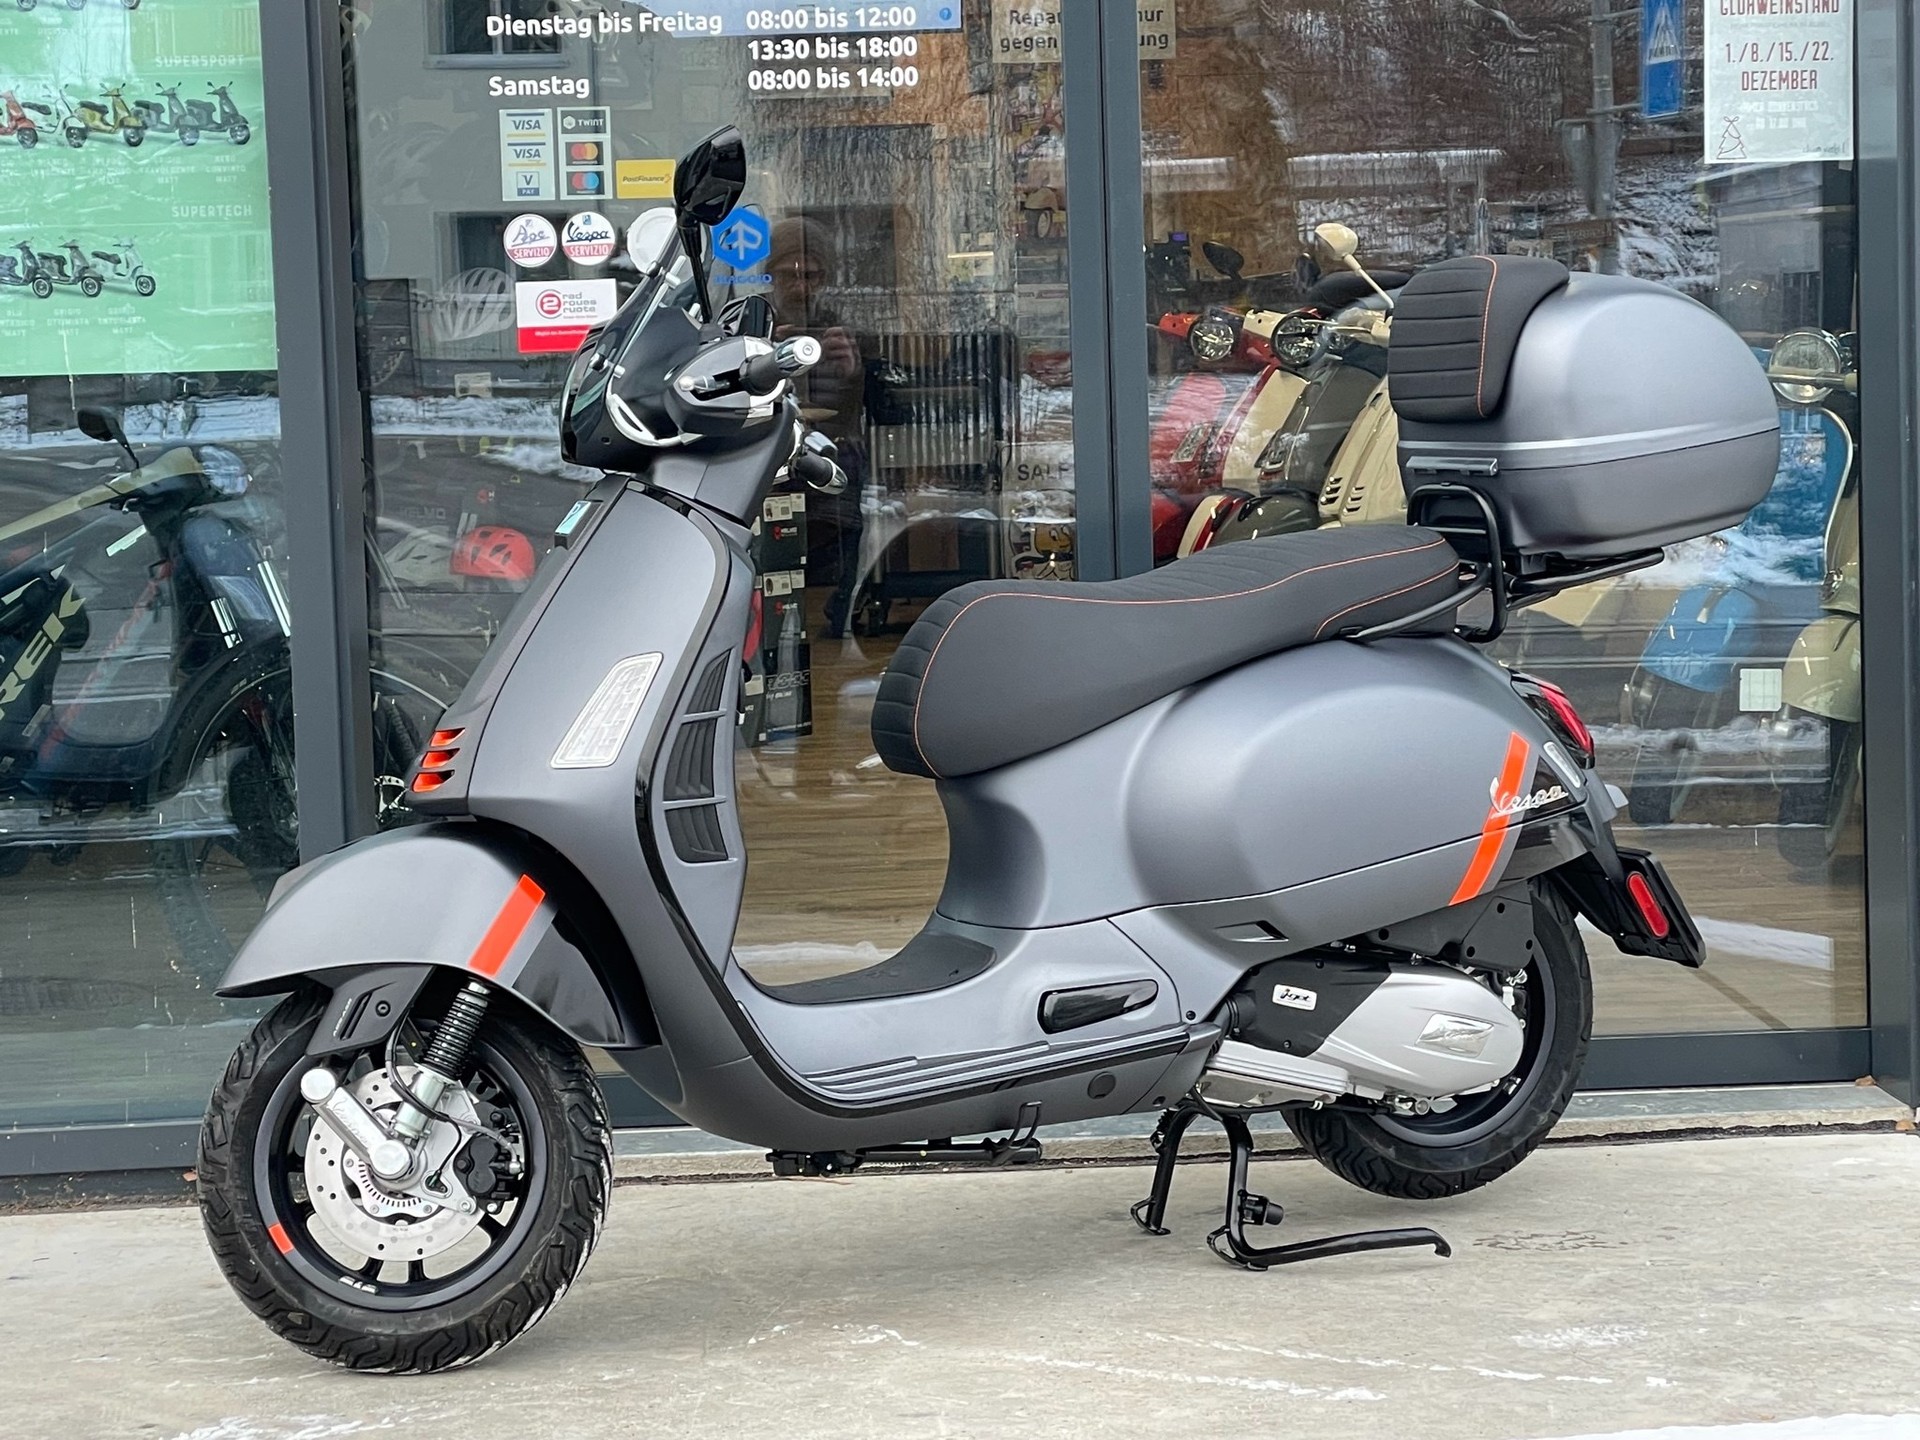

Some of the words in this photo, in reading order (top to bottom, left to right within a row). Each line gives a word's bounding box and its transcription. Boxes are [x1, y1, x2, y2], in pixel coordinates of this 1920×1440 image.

[486, 14, 592, 38] Dienstag
[598, 12, 632, 33] bis
[639, 11, 722, 34] Freitag
[746, 9, 808, 30] 08:00
[815, 7, 848, 28] bis
[855, 7, 916, 27] 12:00
[747, 39, 810, 60] 13:30
[815, 37, 849, 58] bis
[856, 36, 918, 57] 18:00
[1000, 35, 1058, 52] gegen
[155, 55, 245, 68] SUPERSPORT
[488, 76, 590, 98] Samstag
[748, 69, 811, 90] 08:00
[816, 67, 850, 88] bis
[857, 66, 919, 87] 14:00
[1741, 70, 1818, 91] DEZEMBER
[512, 120, 541, 130] VISA
[577, 118, 604, 127] TWINT
[514, 148, 541, 158] VISA
[521, 174, 533, 186] V
[622, 175, 665, 183] PostFinance
[172, 205, 253, 218] SUPERTECH
[565, 221, 611, 243] Vespa
[513, 247, 550, 258] SERVIZIO
[569, 244, 609, 257] SERVIZIO
[563, 292, 583, 300] rad
[1489, 776, 1569, 819] Vespa
